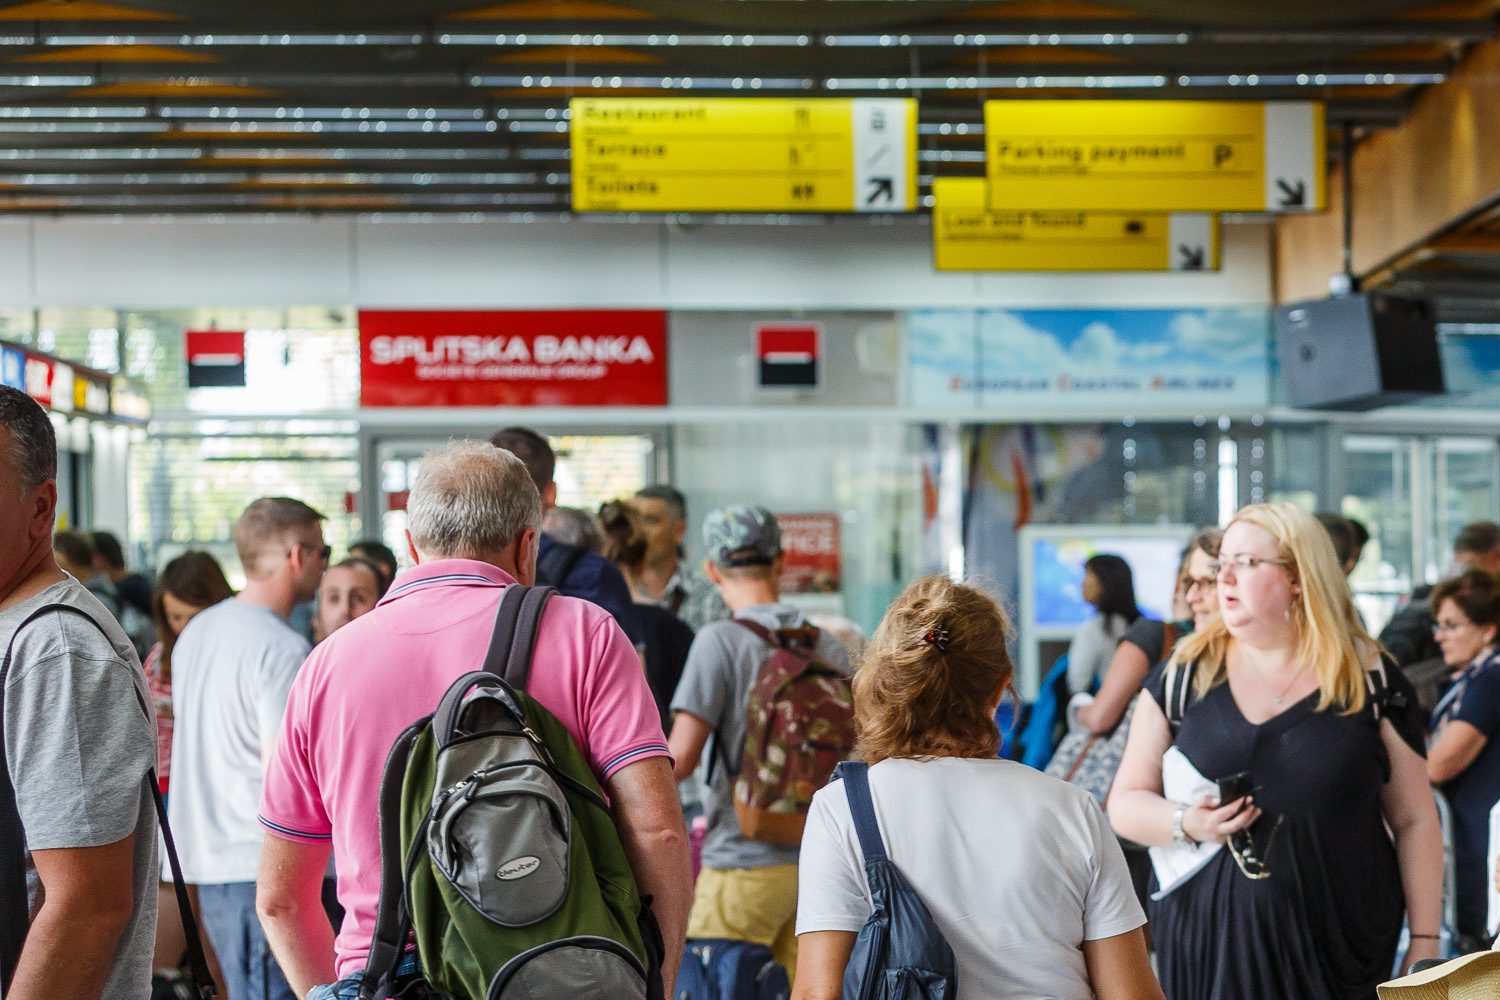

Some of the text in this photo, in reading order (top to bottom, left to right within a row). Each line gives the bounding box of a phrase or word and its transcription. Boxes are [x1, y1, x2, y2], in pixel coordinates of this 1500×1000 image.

[584, 106, 706, 120] Restaurant
[584, 137, 668, 157] Terrace
[998, 142, 1083, 163] Parking
[1090, 142, 1185, 164] payment
[585, 174, 658, 194] Toilets
[369, 335, 654, 365] SPLITSKA BANKA
[948, 373, 1234, 392] EUROPEAN COASTAL AIRLINES
[499, 859, 538, 877] deuter
